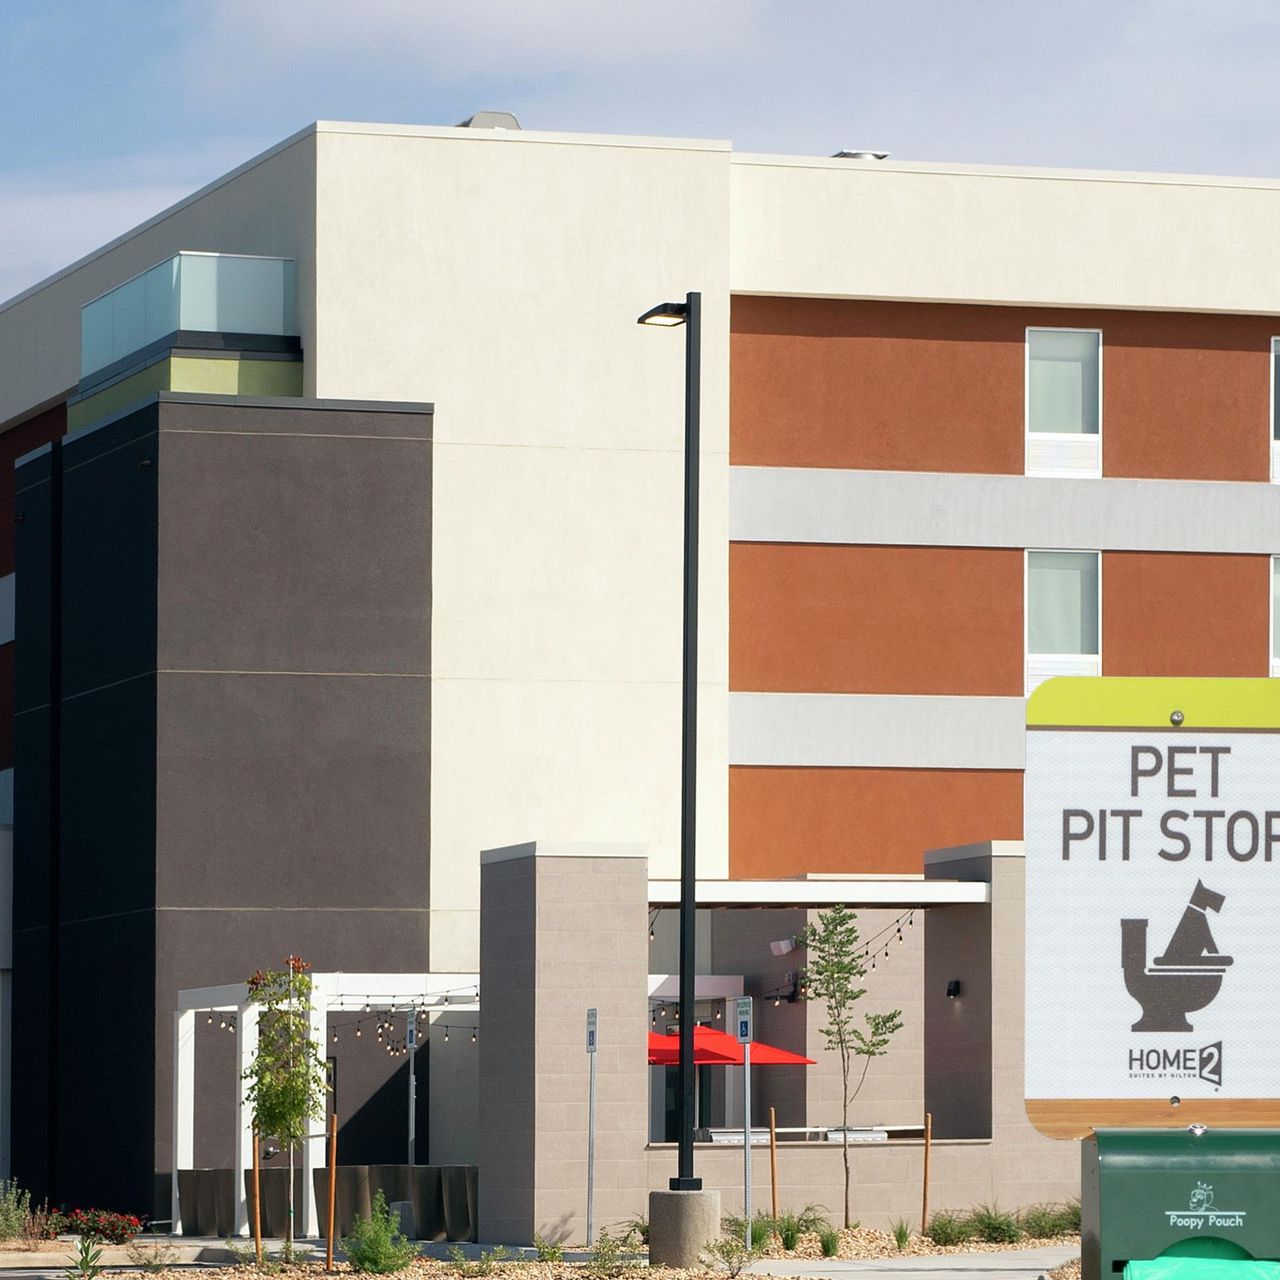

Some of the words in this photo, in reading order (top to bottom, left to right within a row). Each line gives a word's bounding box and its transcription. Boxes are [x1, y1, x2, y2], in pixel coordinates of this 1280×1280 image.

[1130, 745, 1231, 798] PET
[1062, 808, 1143, 861] PIT
[1169, 1215, 1204, 1230] Poopy
[1208, 1215, 1243, 1227] Pouch
